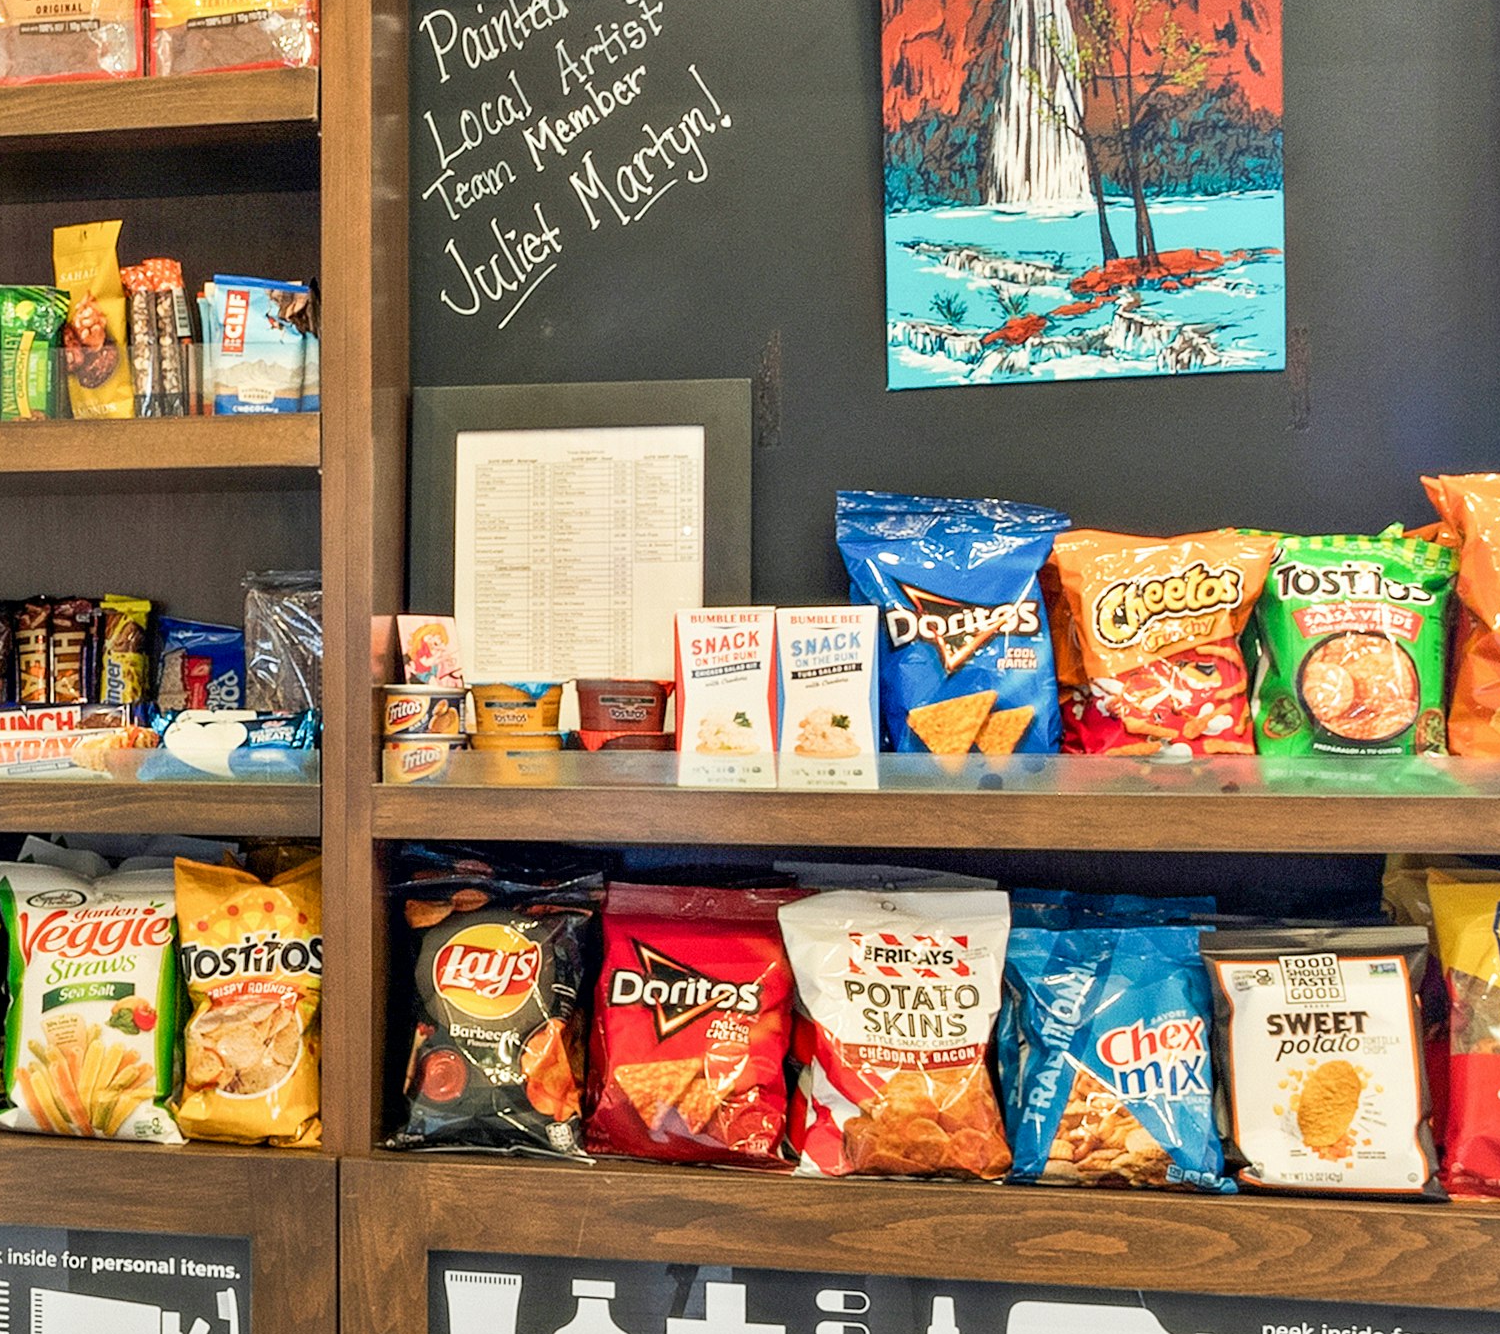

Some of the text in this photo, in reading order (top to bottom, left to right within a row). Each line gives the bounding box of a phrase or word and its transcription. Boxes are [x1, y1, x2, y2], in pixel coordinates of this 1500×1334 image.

[35, 2, 83, 16] ORIGINAL
[424, 1, 663, 168] Local Artist
[422, 66, 646, 220] Team Member
[441, 64, 732, 315] Juliet Martyn!
[225, 294, 248, 334] CLIF
[690, 612, 760, 625] BUMBLE BEE
[1096, 563, 1242, 649] Cheetos
[885, 601, 1041, 649] Doritos
[691, 630, 760, 656] SNACK
[1006, 649, 1036, 660] COOL
[695, 651, 758, 666] ON THE RUN!
[997, 657, 1038, 670] RANCH
[74, 905, 137, 923] garden
[18, 908, 175, 965] Veggie
[46, 952, 137, 984] Straws
[873, 947, 954, 965] FRIDAYS
[1284, 956, 1335, 972] FOOD
[439, 943, 538, 999] Lay's
[1286, 967, 1338, 982] SHOULD
[1288, 976, 1339, 990] TASTE
[59, 982, 116, 1001] Sea Salt
[609, 969, 762, 1013] Doritos
[844, 980, 980, 1012] POTATO
[1290, 986, 1342, 1001] GOOD
[706, 1028, 750, 1044] CHEESE
[711, 1019, 750, 1033] NACHO
[862, 1008, 967, 1037] SKINS
[1266, 1011, 1369, 1038] SWEET
[859, 1047, 916, 1063] CHEDDAR
[932, 1047, 977, 1063] BACON
[1100, 1017, 1204, 1070] Chex
[1276, 1035, 1361, 1063] potato
[1117, 1054, 1211, 1100] mix
[7, 1248, 57, 1267] inside
[62, 1251, 88, 1269] for
[91, 1256, 175, 1275] personal
[181, 1259, 240, 1279] items.
